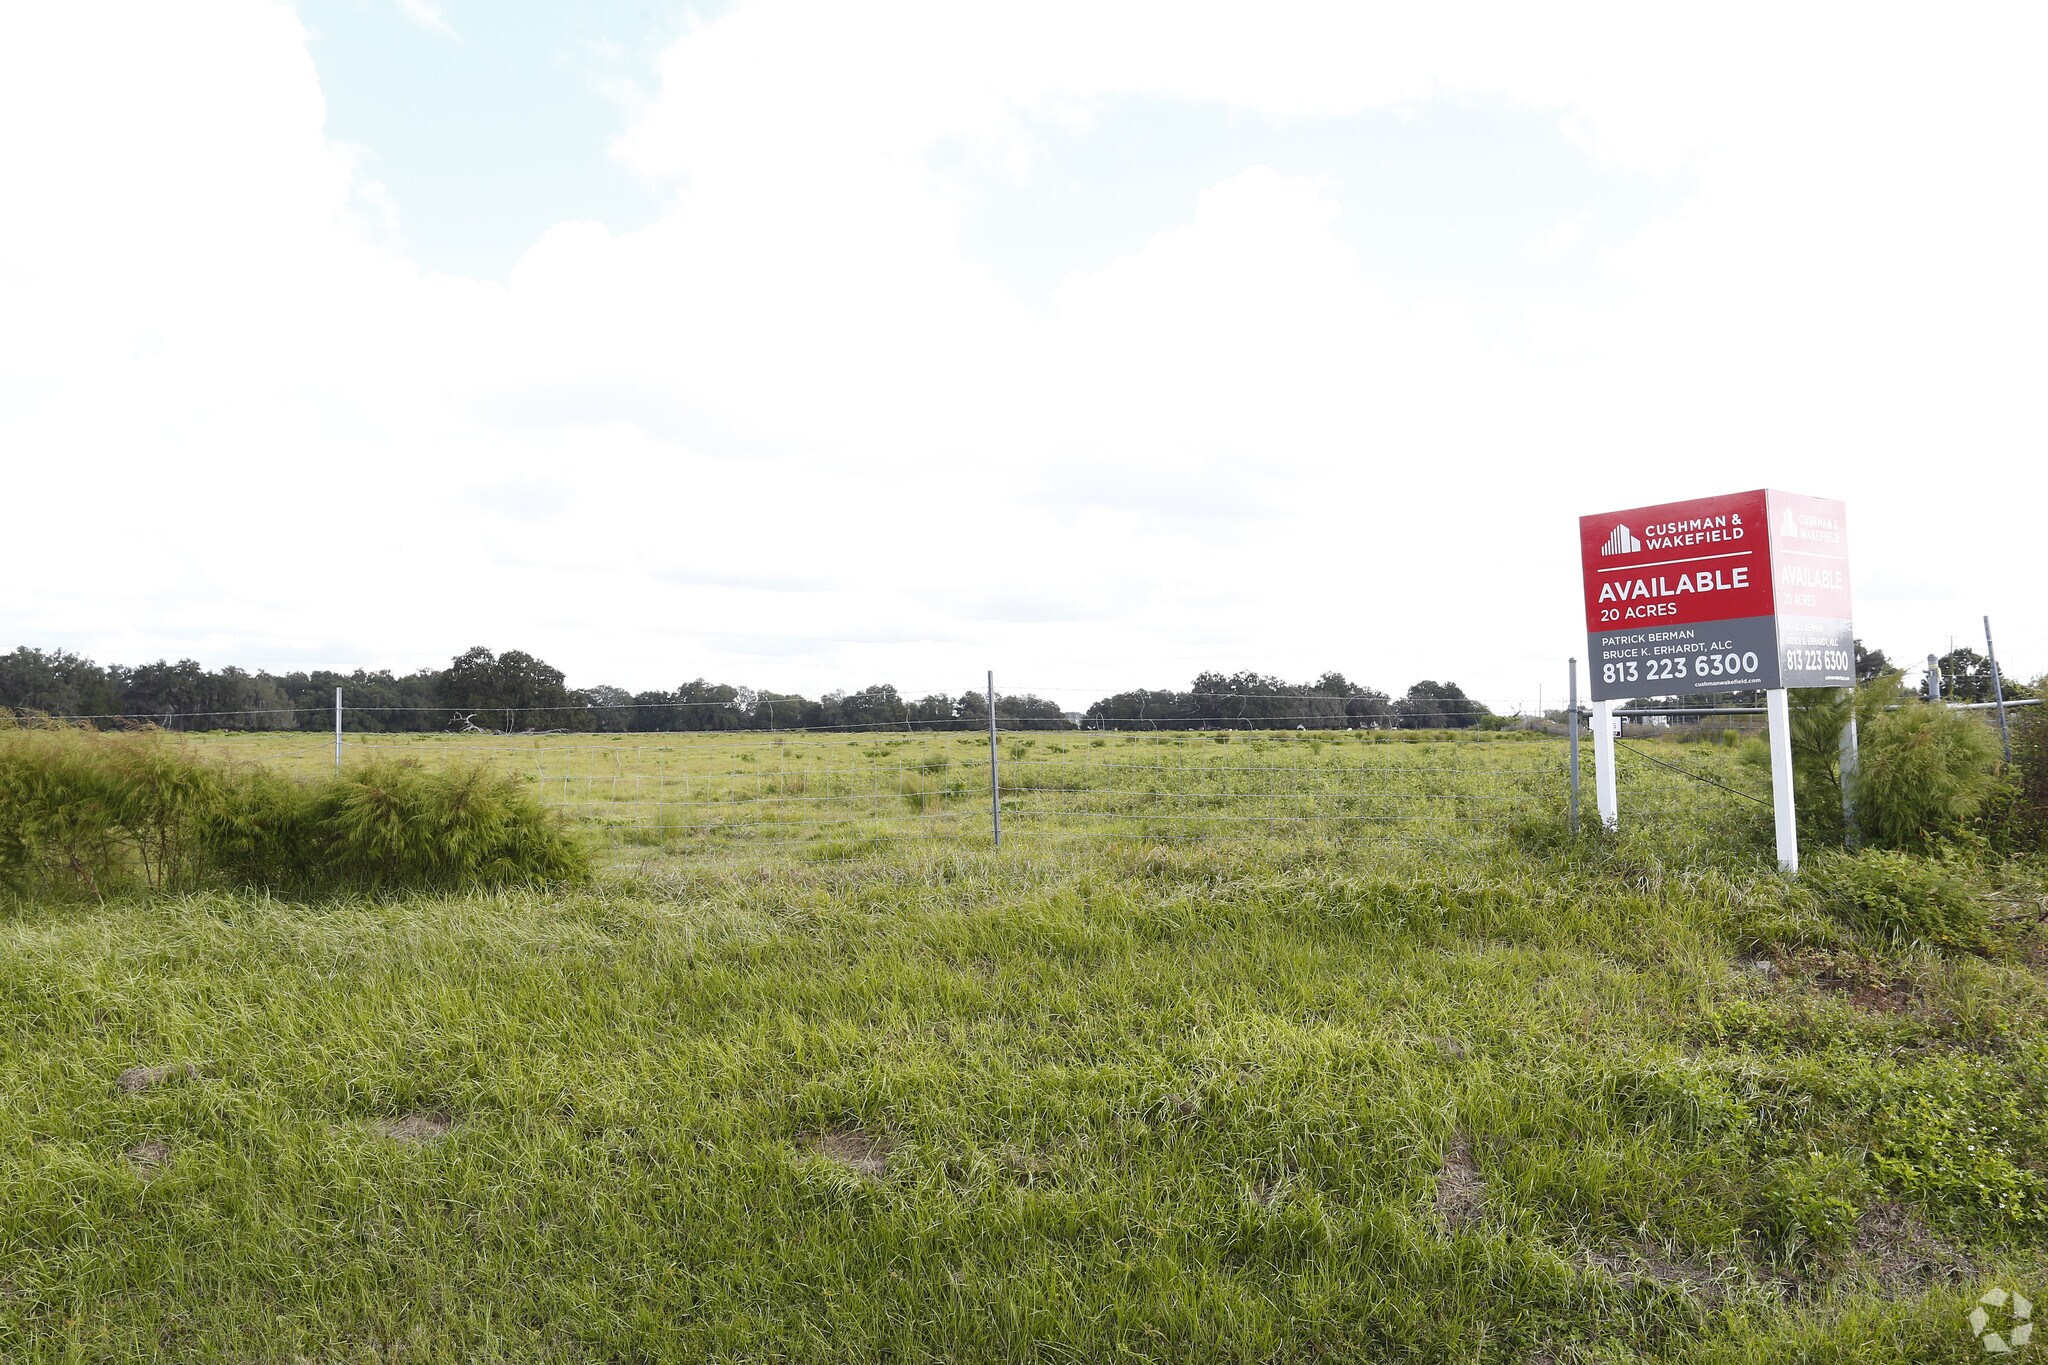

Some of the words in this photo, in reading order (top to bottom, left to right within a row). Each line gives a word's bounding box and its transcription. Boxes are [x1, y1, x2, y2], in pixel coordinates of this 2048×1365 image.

[1646, 516, 1726, 536] CUSHMAN
[1732, 514, 1742, 525] &
[1799, 514, 1832, 529] CUSHMAN
[1646, 528, 1744, 550] WAKEFIELD
[1800, 528, 1839, 543] WAKEFIELD
[1598, 567, 1749, 603] AVAILABLE
[1781, 565, 1842, 589] AVAILABLE
[1783, 593, 1791, 604] 20
[1794, 593, 1816, 606] ACRES
[1601, 609, 1619, 621] 20
[1625, 602, 1677, 619] ACRES
[1602, 635, 1646, 646] PATRICK
[1649, 630, 1694, 642] BERMAN
[1603, 648, 1638, 660] BRUCE
[1641, 647, 1650, 656] K.
[1654, 642, 1707, 655] ERHARDT,
[1710, 641, 1732, 651] ALC
[1787, 649, 1802, 670] 813
[1805, 650, 1822, 670] 223
[1824, 651, 1848, 671] 6300
[1603, 662, 1638, 684] 813
[1646, 658, 1687, 680] 223
[1695, 652, 1758, 677] 6300
[1695, 678, 1761, 687] cushmanwakefield.com
